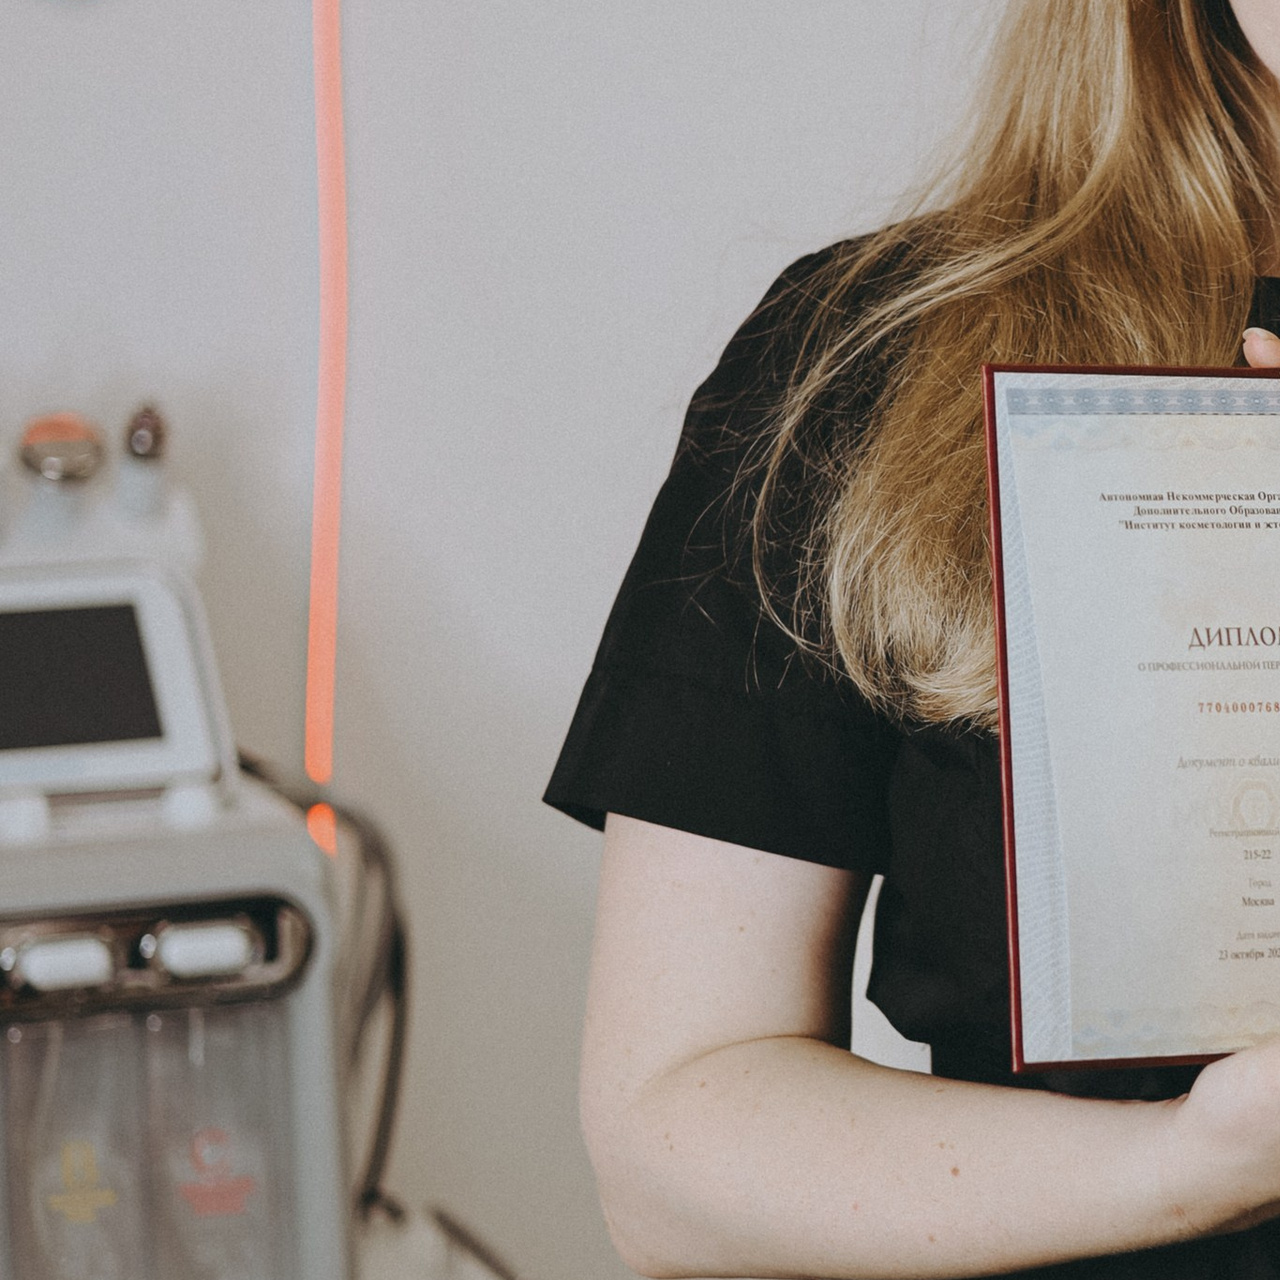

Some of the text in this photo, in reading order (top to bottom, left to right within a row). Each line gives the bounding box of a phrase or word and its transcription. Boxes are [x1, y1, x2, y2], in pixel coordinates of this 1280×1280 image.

[1099, 491, 1164, 502] Автономная
[1166, 491, 1256, 503] Некоммерческая
[1133, 505, 1227, 517] Дополнительного
[1179, 521, 1252, 531] косметологии
[1254, 521, 1261, 530] и
[1148, 660, 1261, 672] ПРОФЕССИОНАЛЬНОЙ
[1241, 896, 1275, 907] Москва
